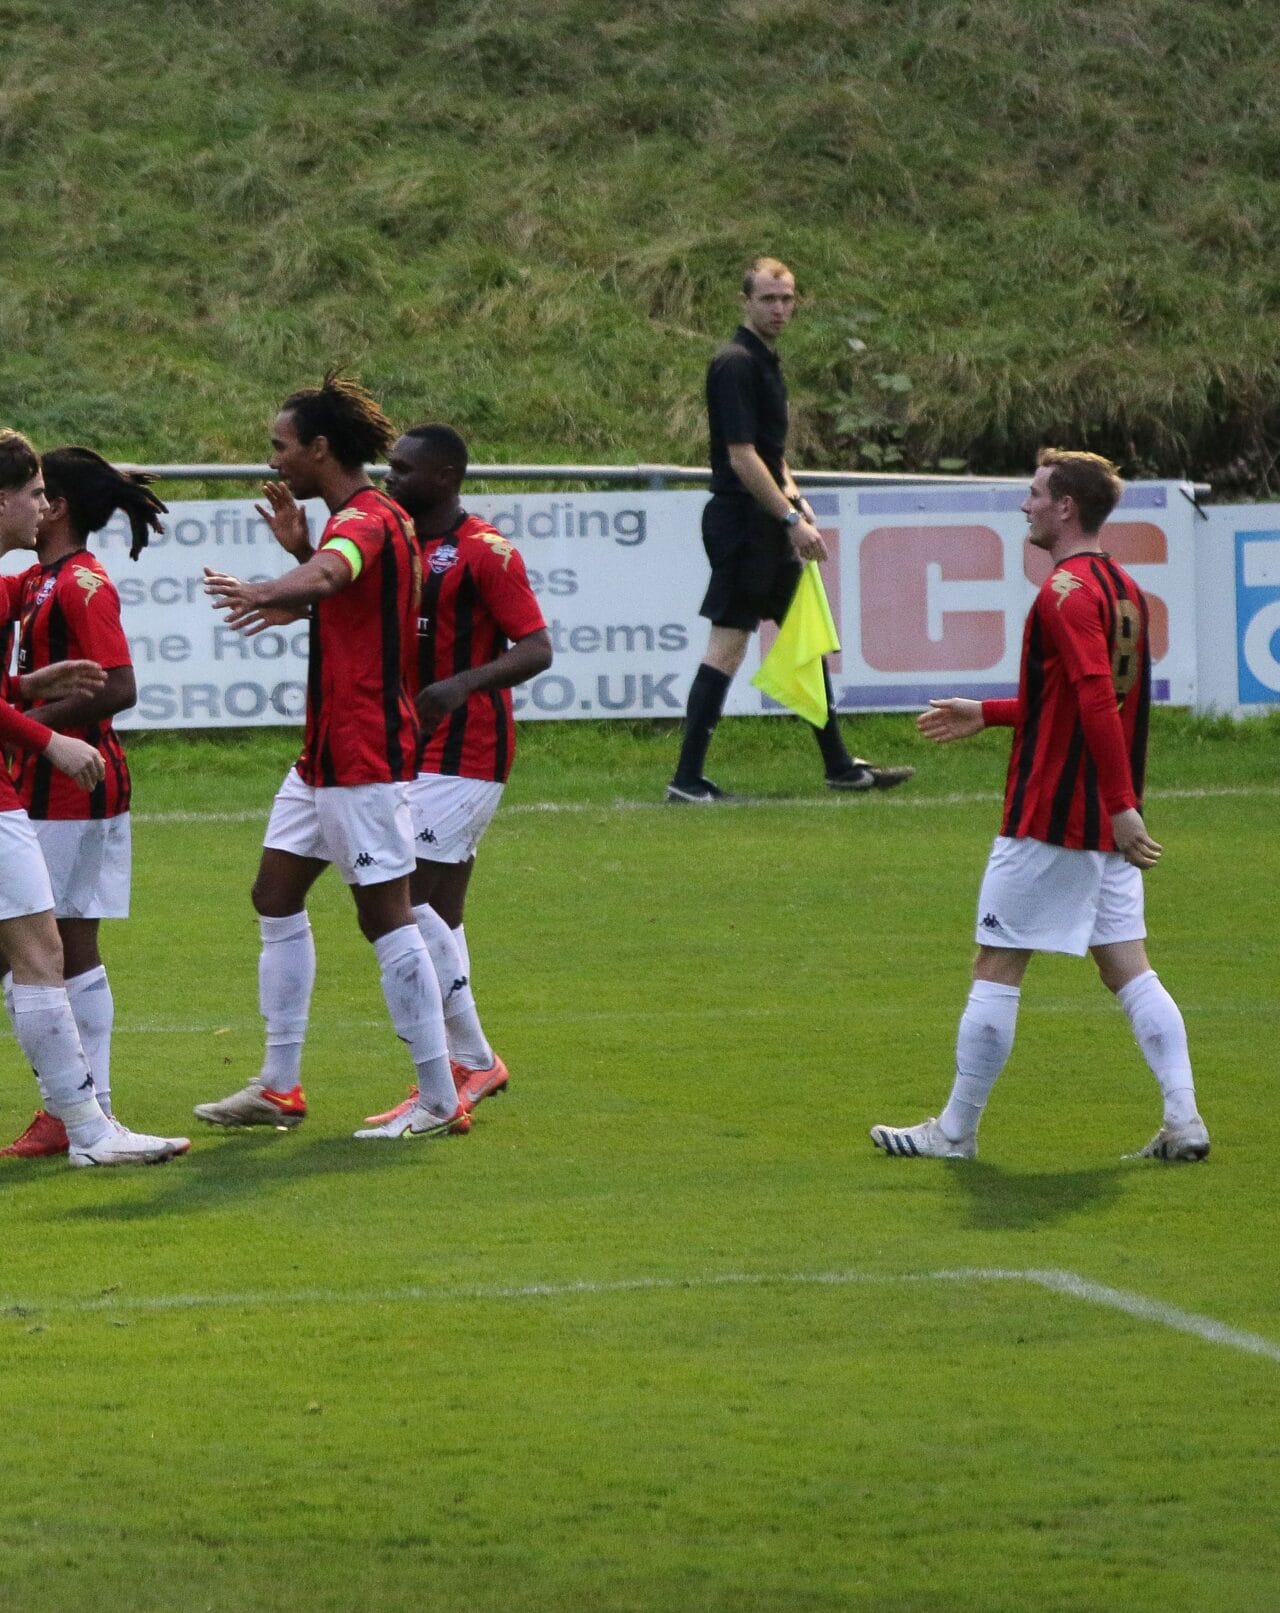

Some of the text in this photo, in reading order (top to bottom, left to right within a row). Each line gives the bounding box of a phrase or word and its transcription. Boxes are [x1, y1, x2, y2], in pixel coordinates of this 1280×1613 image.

[491, 502, 648, 546] dding
[552, 618, 689, 655] tems
[1111, 599, 1141, 695] 8
